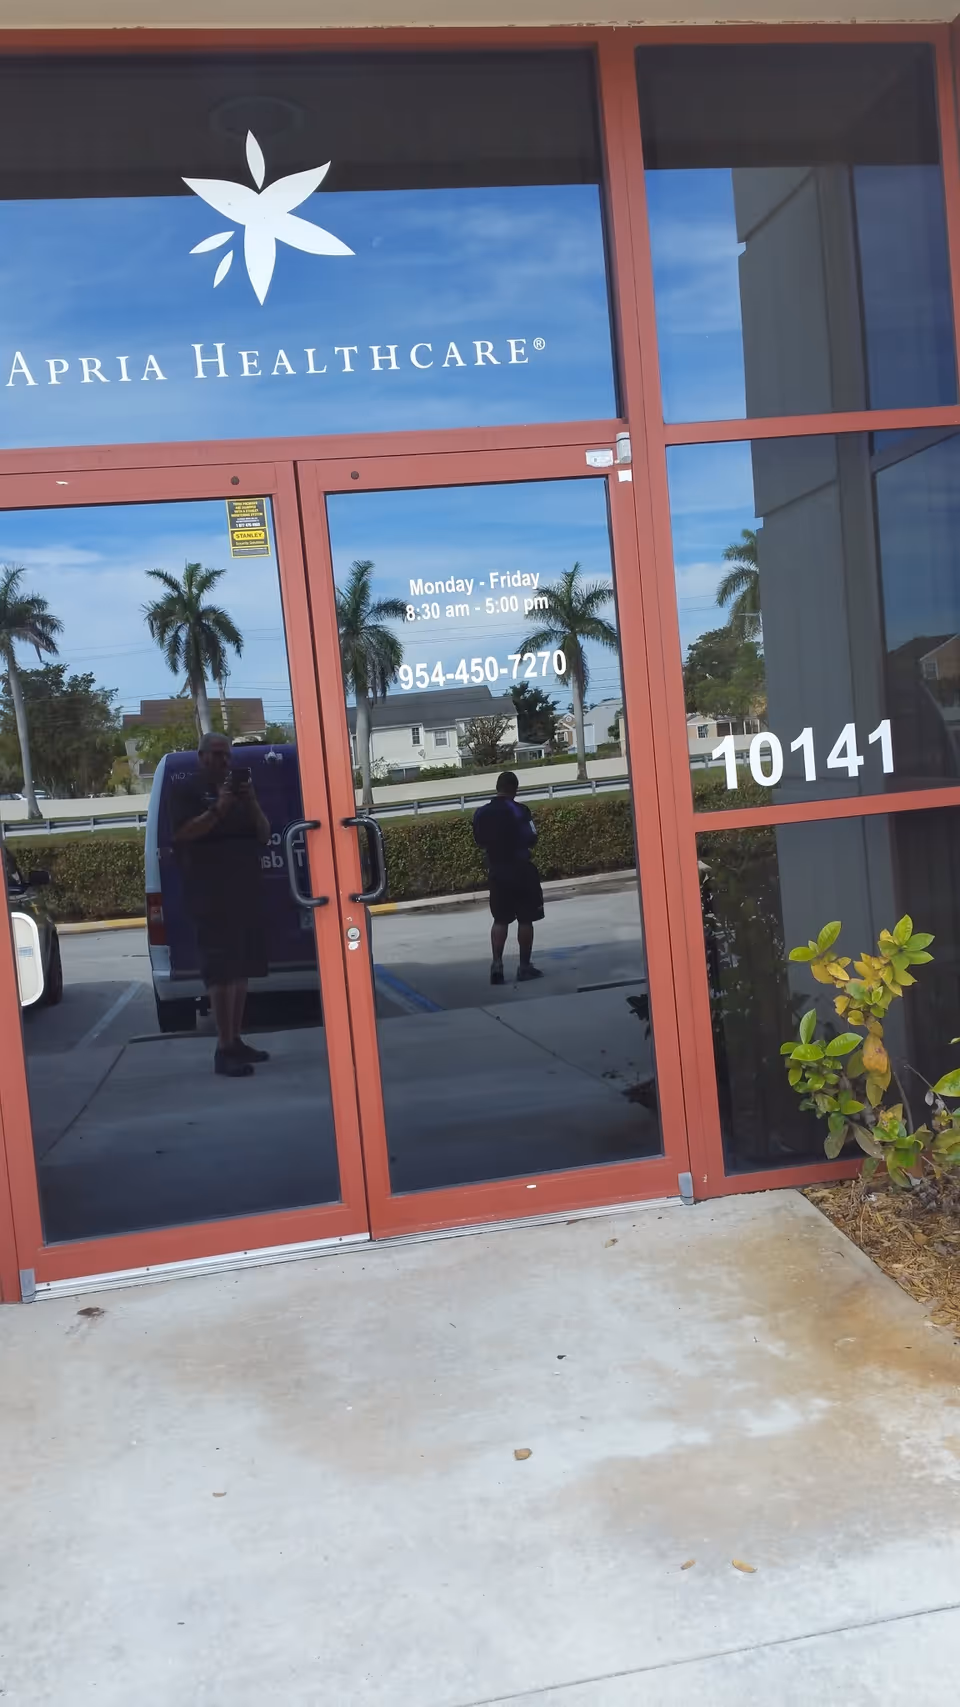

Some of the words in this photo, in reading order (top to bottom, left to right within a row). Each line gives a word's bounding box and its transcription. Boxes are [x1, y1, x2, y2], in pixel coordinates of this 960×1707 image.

[5, 351, 168, 387] APRIA
[409, 575, 474, 596] Monday
[489, 570, 540, 589] Friday
[405, 602, 440, 621] 8:30
[445, 603, 470, 618] am
[485, 595, 518, 614] 5:00
[523, 596, 549, 615] pm
[398, 649, 567, 690] 954-450-7270
[711, 718, 895, 790] 10141
